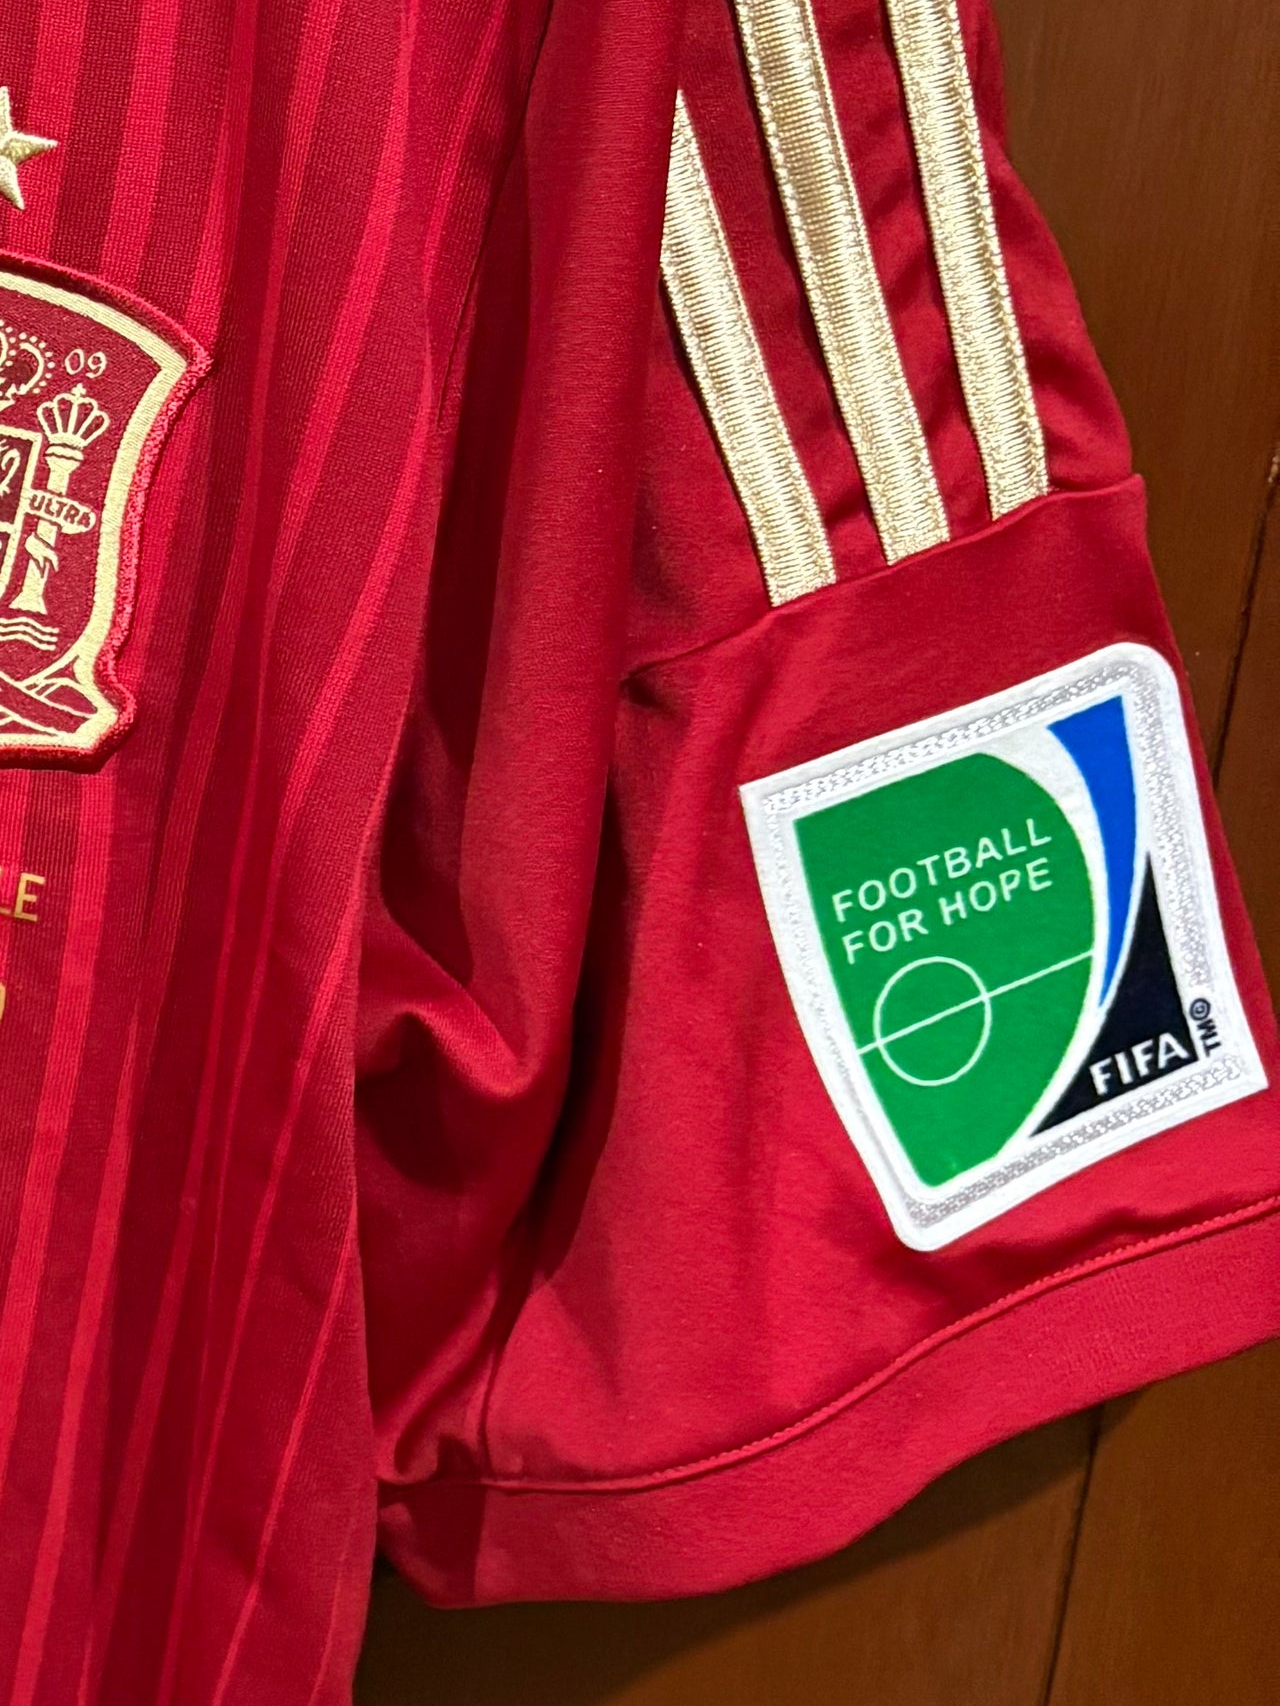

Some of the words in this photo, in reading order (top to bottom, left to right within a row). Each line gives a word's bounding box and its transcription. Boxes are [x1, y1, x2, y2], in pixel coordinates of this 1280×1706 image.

[63, 347, 108, 378] 09
[29, 492, 93, 531] ULTRA
[831, 817, 1053, 924] FOOTBALL
[841, 908, 930, 966] FOR
[938, 856, 1054, 927] HOPE
[1089, 1031, 1191, 1097] FIFA
